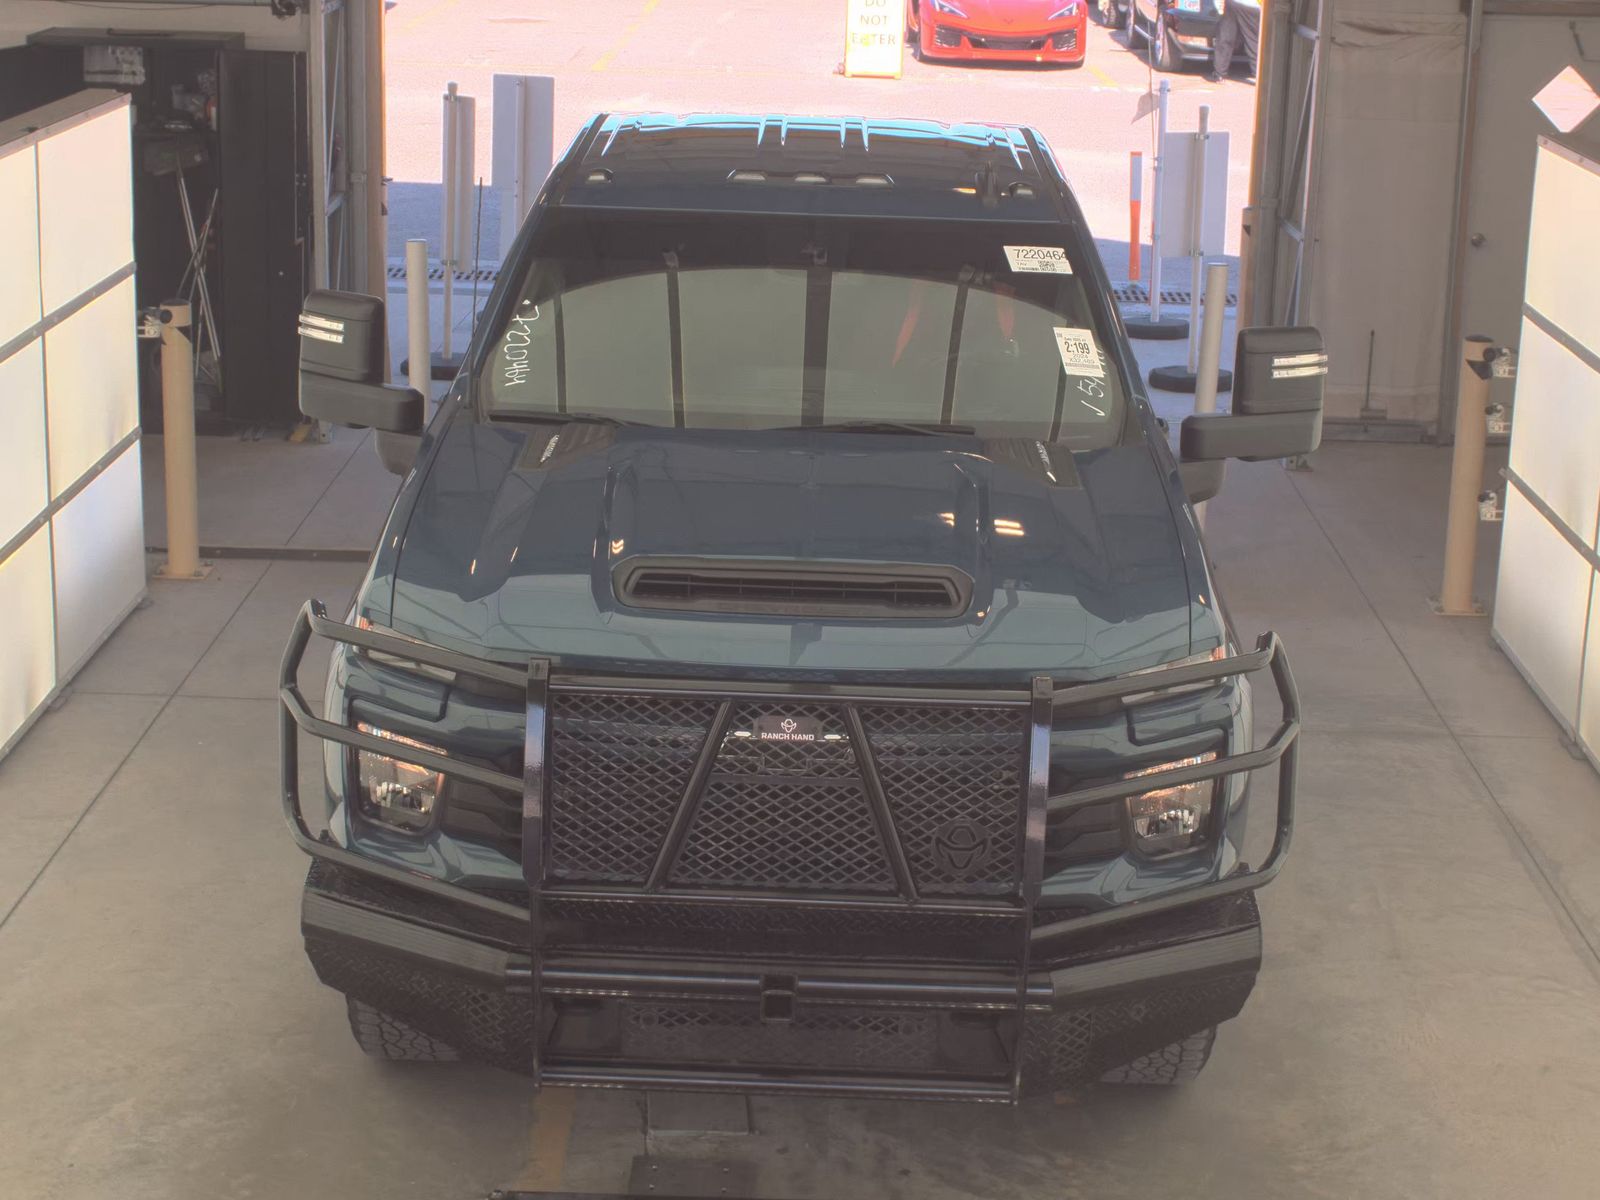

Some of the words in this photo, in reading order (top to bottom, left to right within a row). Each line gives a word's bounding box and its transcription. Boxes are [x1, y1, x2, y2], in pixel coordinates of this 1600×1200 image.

[860, 15, 888, 25] NOT
[761, 732, 790, 740] RANCH
[791, 733, 815, 741] HAND
